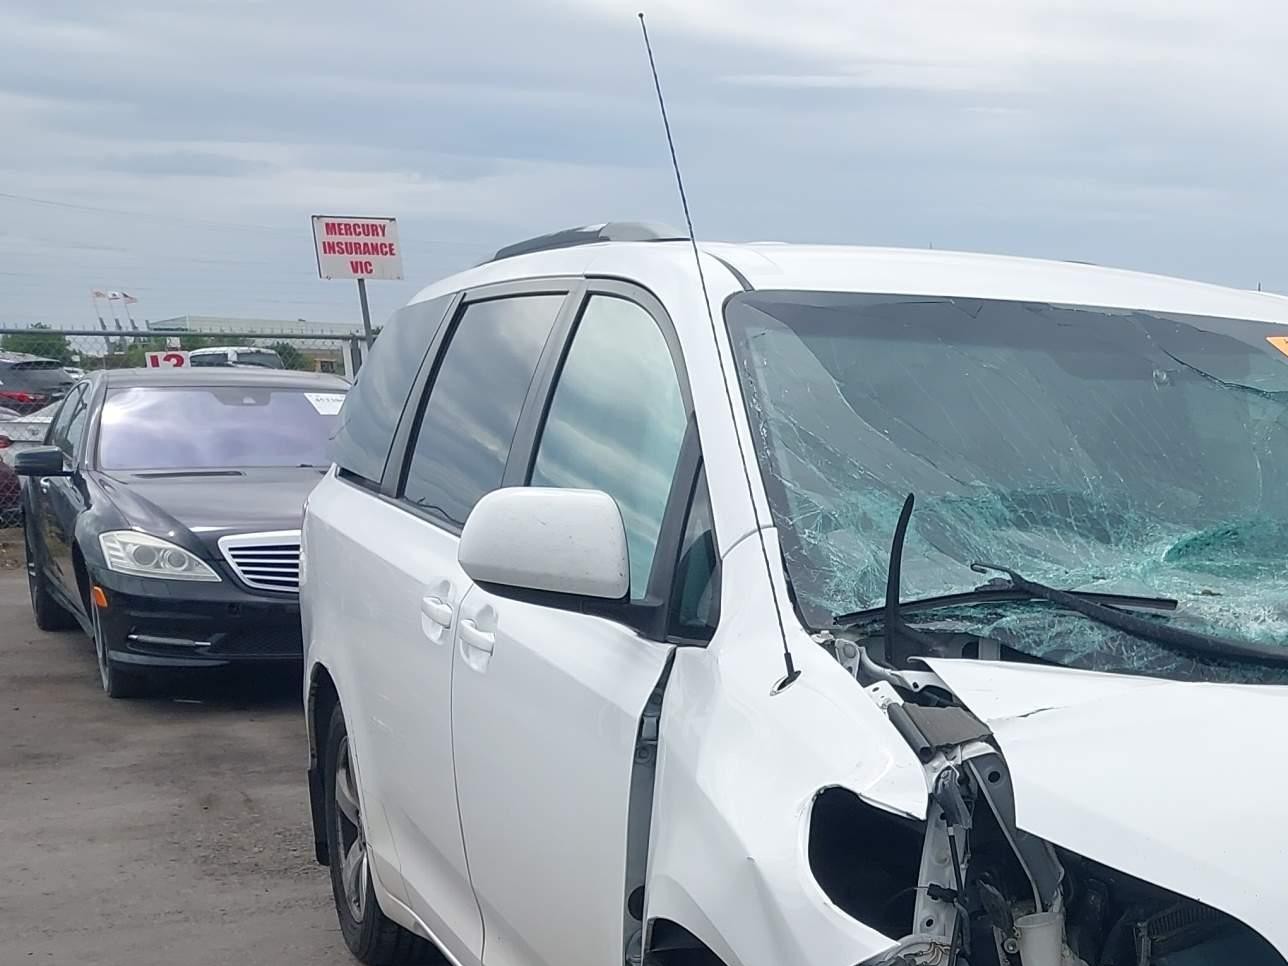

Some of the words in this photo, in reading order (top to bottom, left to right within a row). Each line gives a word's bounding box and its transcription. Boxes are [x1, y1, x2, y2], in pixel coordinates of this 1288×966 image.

[325, 222, 387, 237] MERCURY
[322, 241, 396, 256] INSURANCE
[350, 261, 374, 274] VIC
